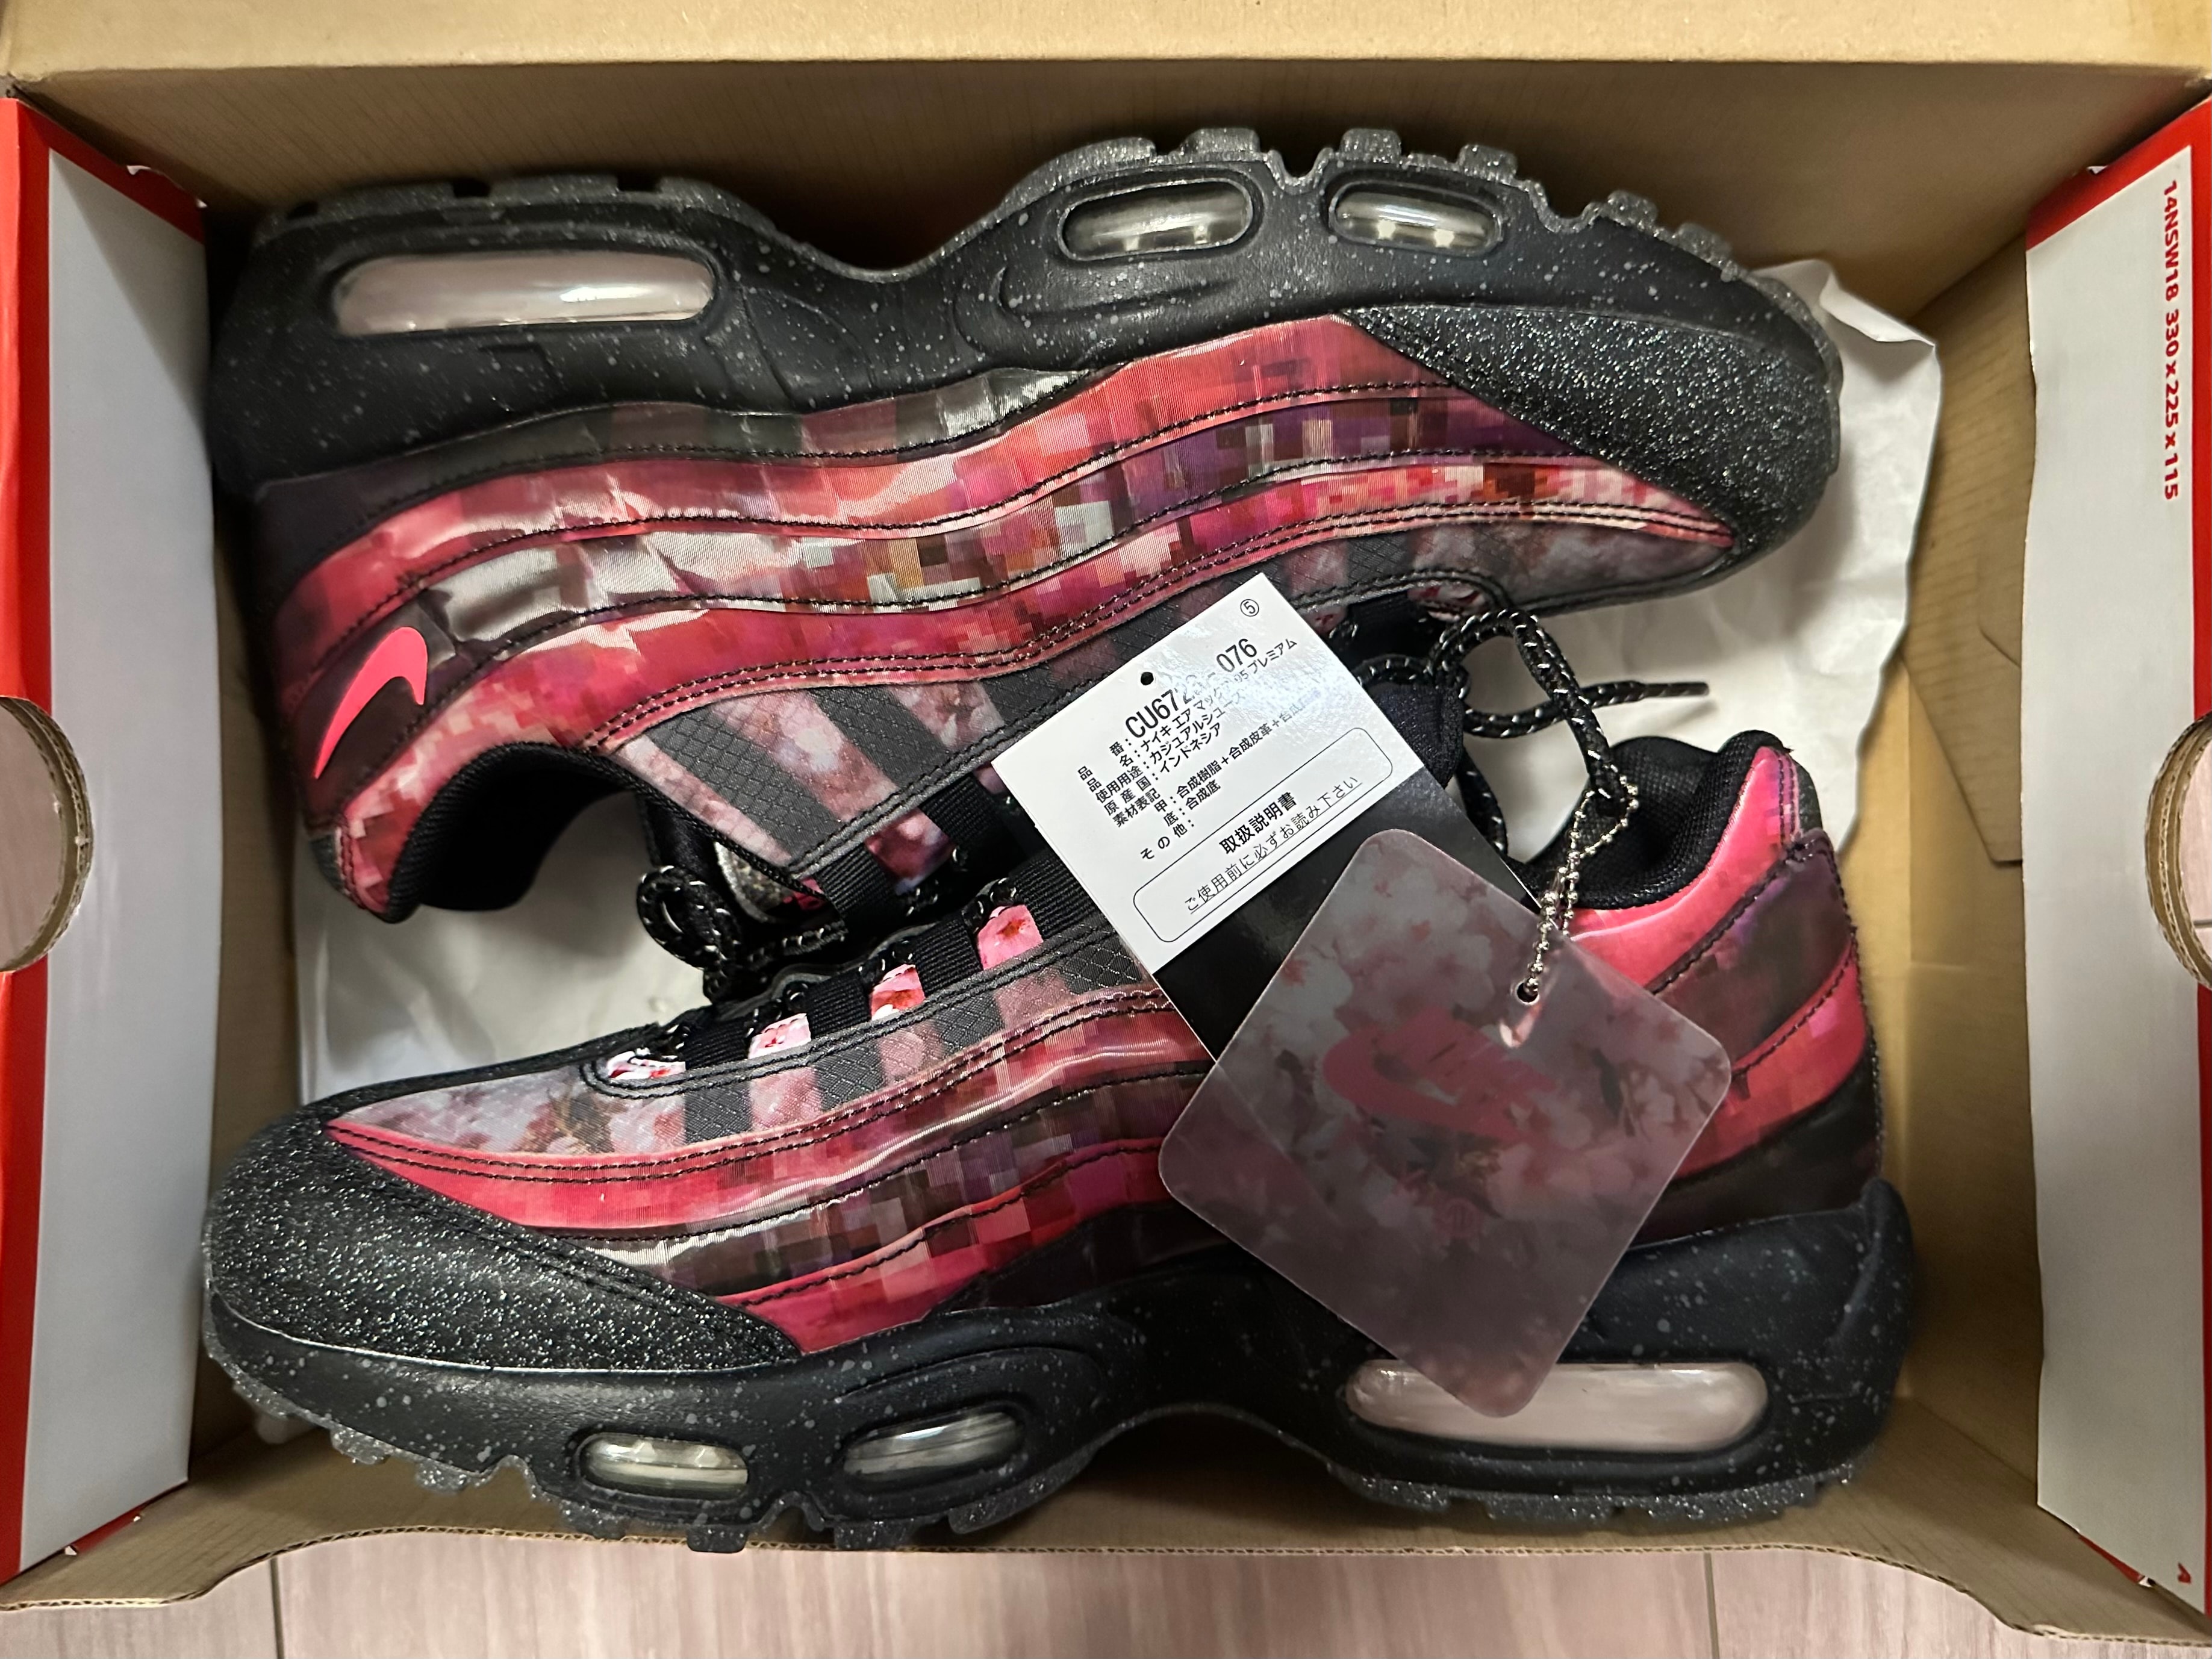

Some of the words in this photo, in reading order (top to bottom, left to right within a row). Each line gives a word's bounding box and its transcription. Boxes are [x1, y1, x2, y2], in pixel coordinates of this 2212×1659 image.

[2164, 179, 2179, 302] 14NSW18
[1248, 638, 1298, 674] プレミアム
[1112, 788, 1161, 827] 素材表記
[1185, 779, 1221, 811] 合成底
[1185, 776, 1359, 912] ご使用前に必ずお読み下さい
[1218, 791, 1298, 855] 取扱説明書
